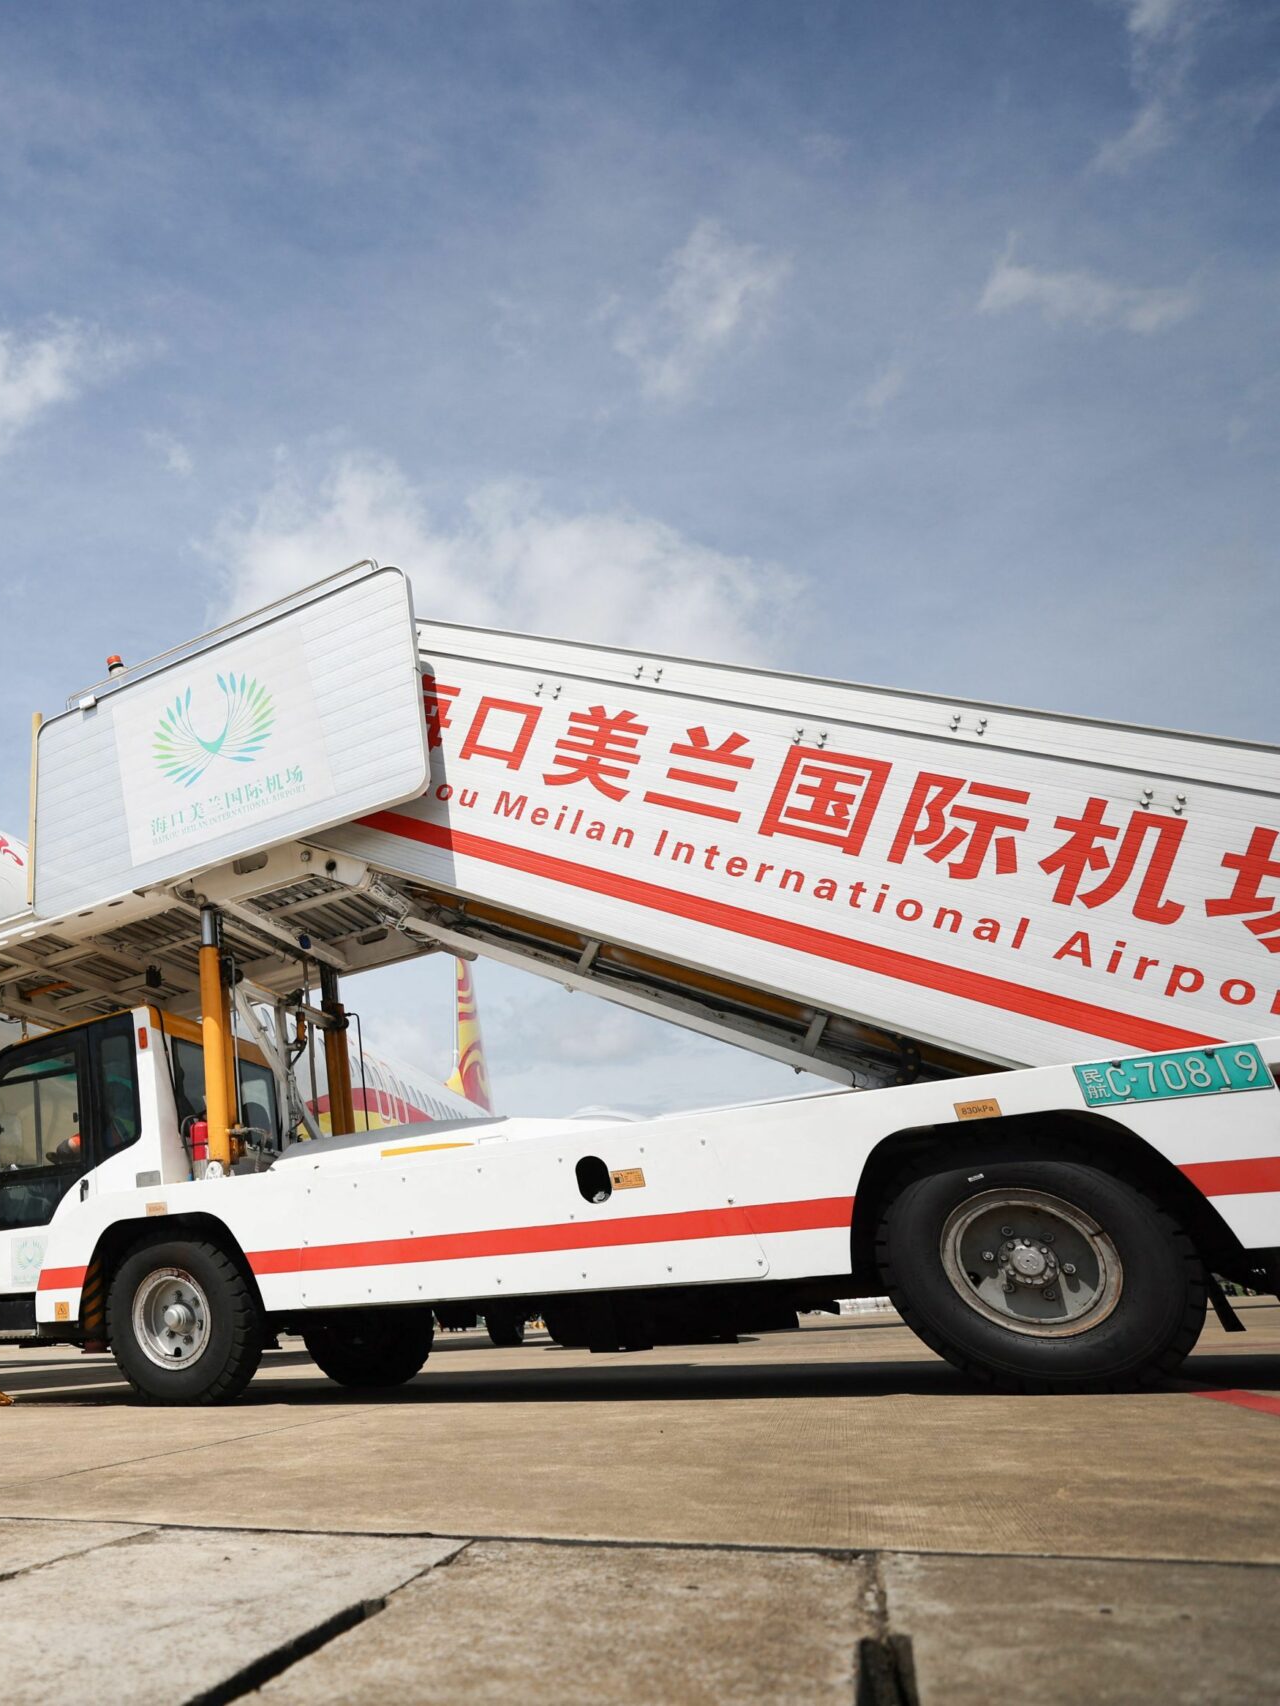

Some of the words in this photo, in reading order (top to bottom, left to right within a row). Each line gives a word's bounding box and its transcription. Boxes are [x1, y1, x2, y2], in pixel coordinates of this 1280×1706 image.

[151, 765, 304, 836] 海口美兰国际机场
[209, 798, 271, 826] INTERNATIONAL
[272, 784, 307, 803] AIRPORT
[493, 790, 635, 848] Meilan
[653, 829, 1031, 950] International
[1081, 1069, 1111, 1099] 民航
[960, 1104, 994, 1115] 830kPa
